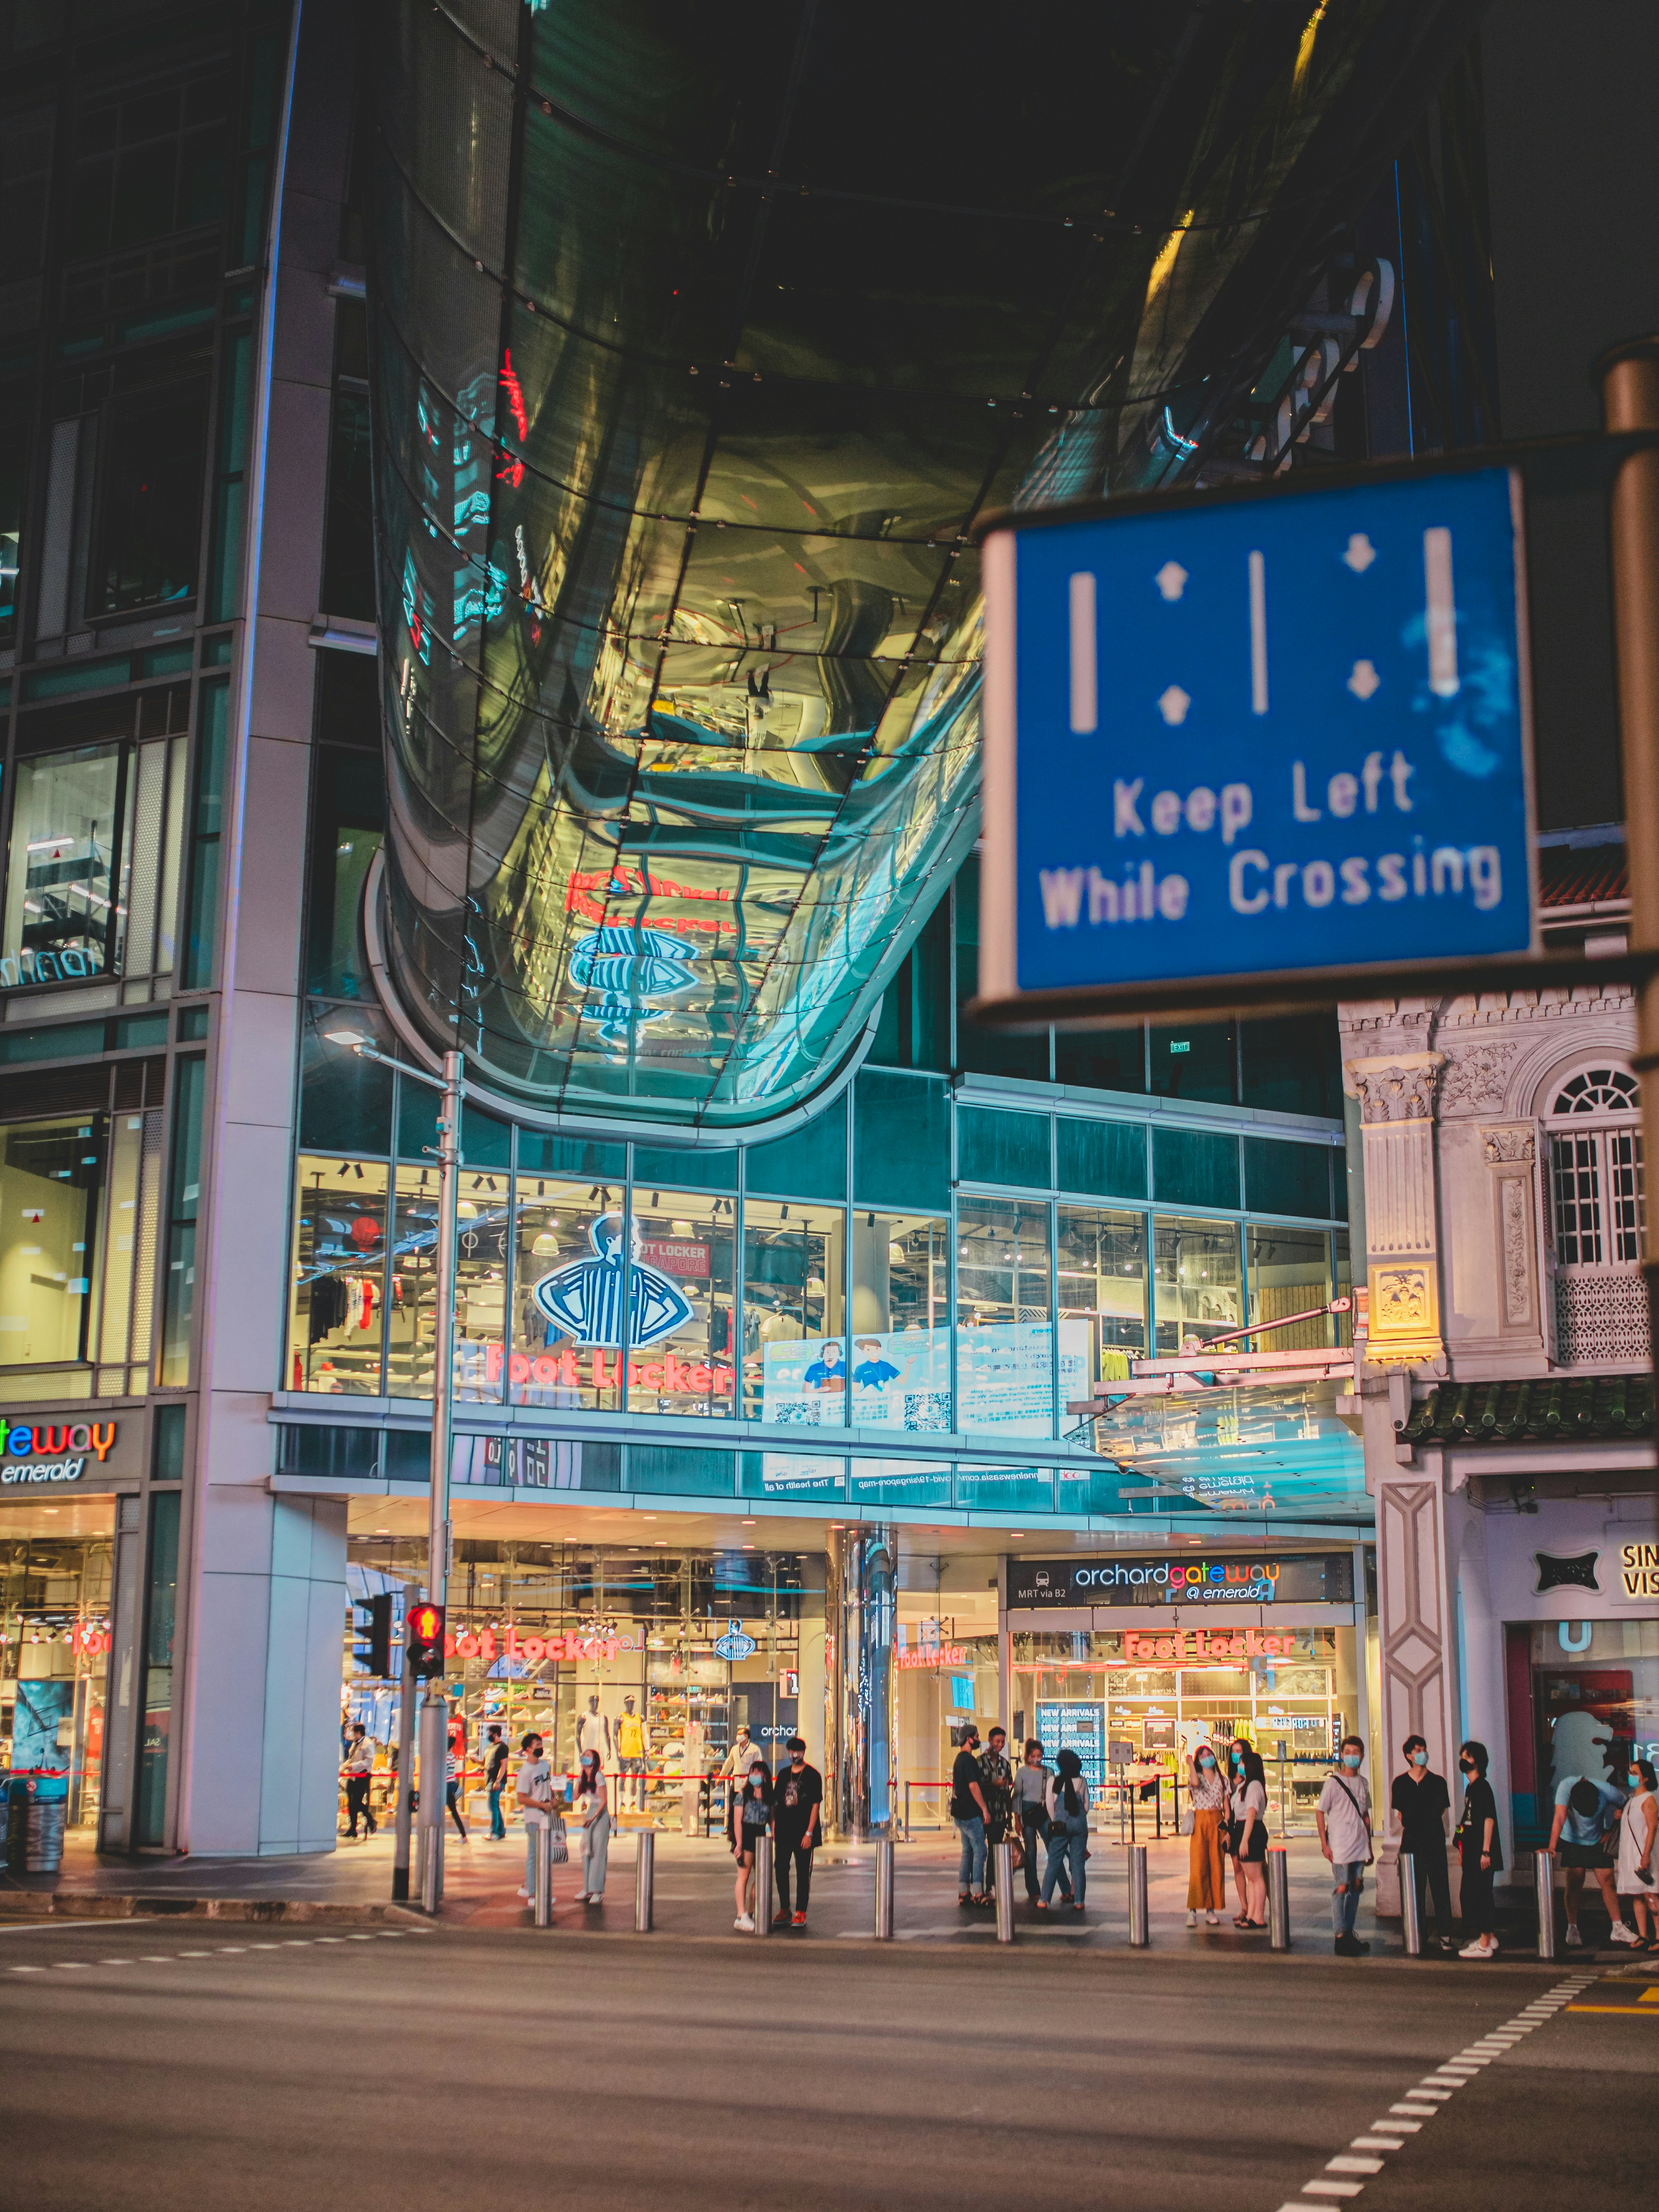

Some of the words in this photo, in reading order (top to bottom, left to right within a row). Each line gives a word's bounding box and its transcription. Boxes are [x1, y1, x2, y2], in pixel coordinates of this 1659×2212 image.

[1114, 778, 1252, 846] Keep
[1293, 750, 1414, 822] Left
[1040, 860, 1189, 929] While
[1229, 834, 1502, 911] Crossing
[639, 1255, 705, 1272] NGAPORE
[641, 1243, 656, 1254] OT
[659, 1245, 705, 1259] LOCKER
[486, 1343, 580, 1386] Foot
[593, 1350, 731, 1393] Locker
[2, 1458, 84, 1484] emerald
[1623, 1545, 1659, 1568] SIN
[1075, 1562, 1280, 1589] orchardgateway
[1018, 1589, 1038, 1599] MRT
[1040, 1588, 1052, 1598] via
[1054, 1588, 1066, 1598] B2
[1203, 1585, 1260, 1599] emerald
[445, 1629, 497, 1660] oot
[506, 1629, 618, 1662] Locker
[900, 1645, 924, 1669] Foot
[925, 1641, 965, 1668] Locker
[1125, 1633, 1187, 1659] Foot
[1196, 1630, 1296, 1657] Locker
[761, 1725, 797, 1737] orchar
